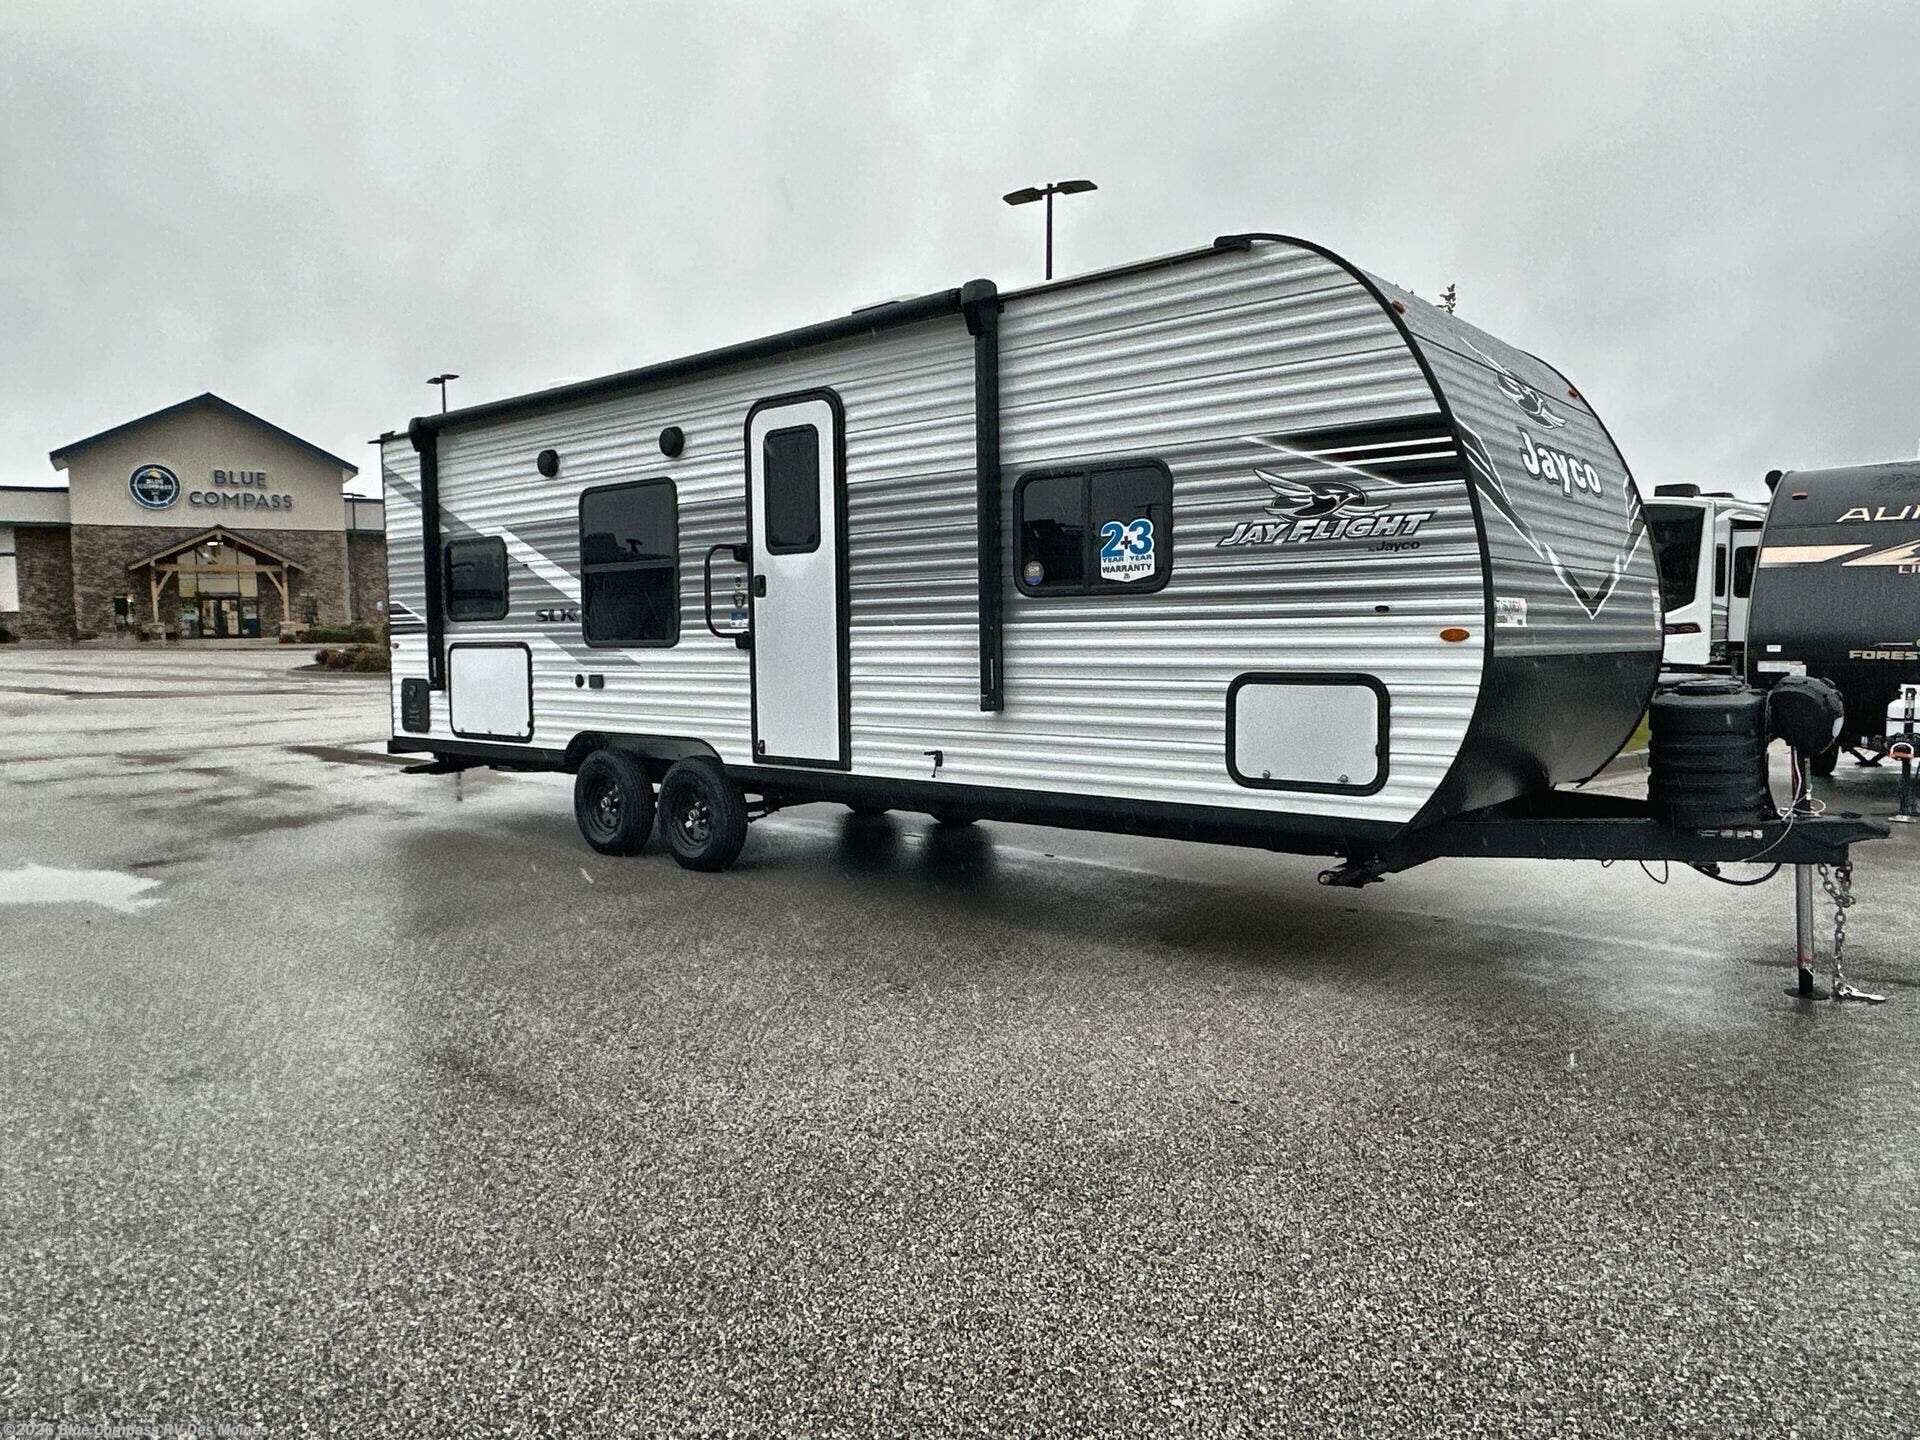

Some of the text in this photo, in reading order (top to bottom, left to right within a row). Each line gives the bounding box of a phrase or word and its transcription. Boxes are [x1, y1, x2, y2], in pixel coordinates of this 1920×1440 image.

[1518, 427, 1603, 498] Jayco
[213, 469, 267, 487] BLUE
[189, 490, 293, 511] COMPASS
[1217, 511, 1438, 547] JAY FLIGHT
[1376, 540, 1421, 552] Jayco
[1102, 563, 1152, 573] WARRANTY
[1899, 564, 1920, 574] LI
[1849, 650, 1920, 660] FORES
